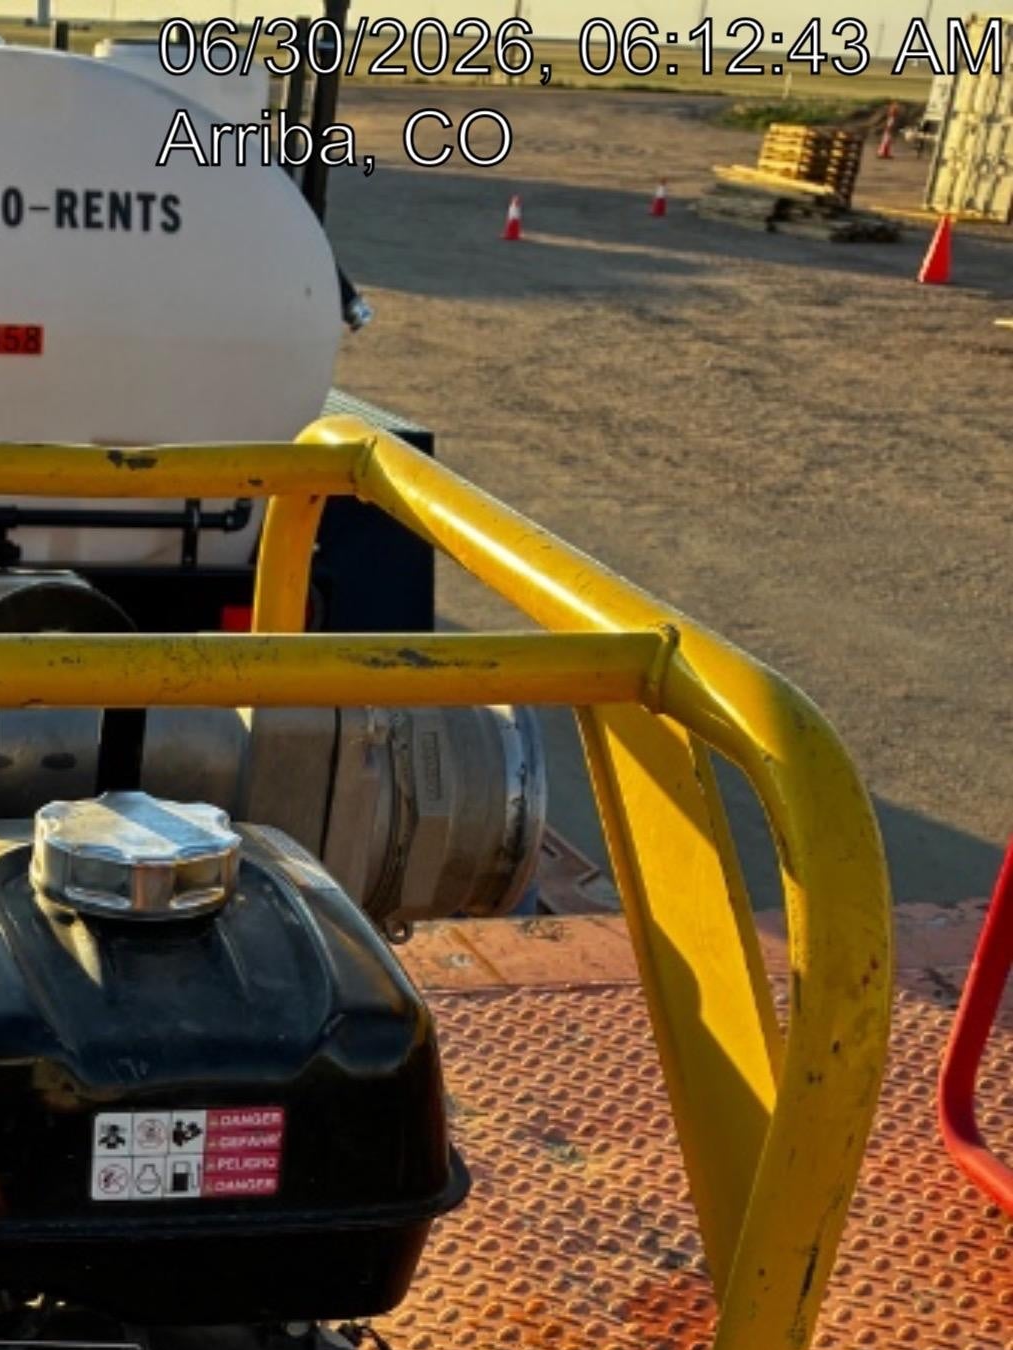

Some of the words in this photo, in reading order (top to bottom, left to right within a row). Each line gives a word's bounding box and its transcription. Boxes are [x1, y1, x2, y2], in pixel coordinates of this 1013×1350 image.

[220, 1111, 282, 1126] DANGER
[217, 1157, 277, 1170] PELIGRO
[214, 1178, 277, 1192] DANGER
